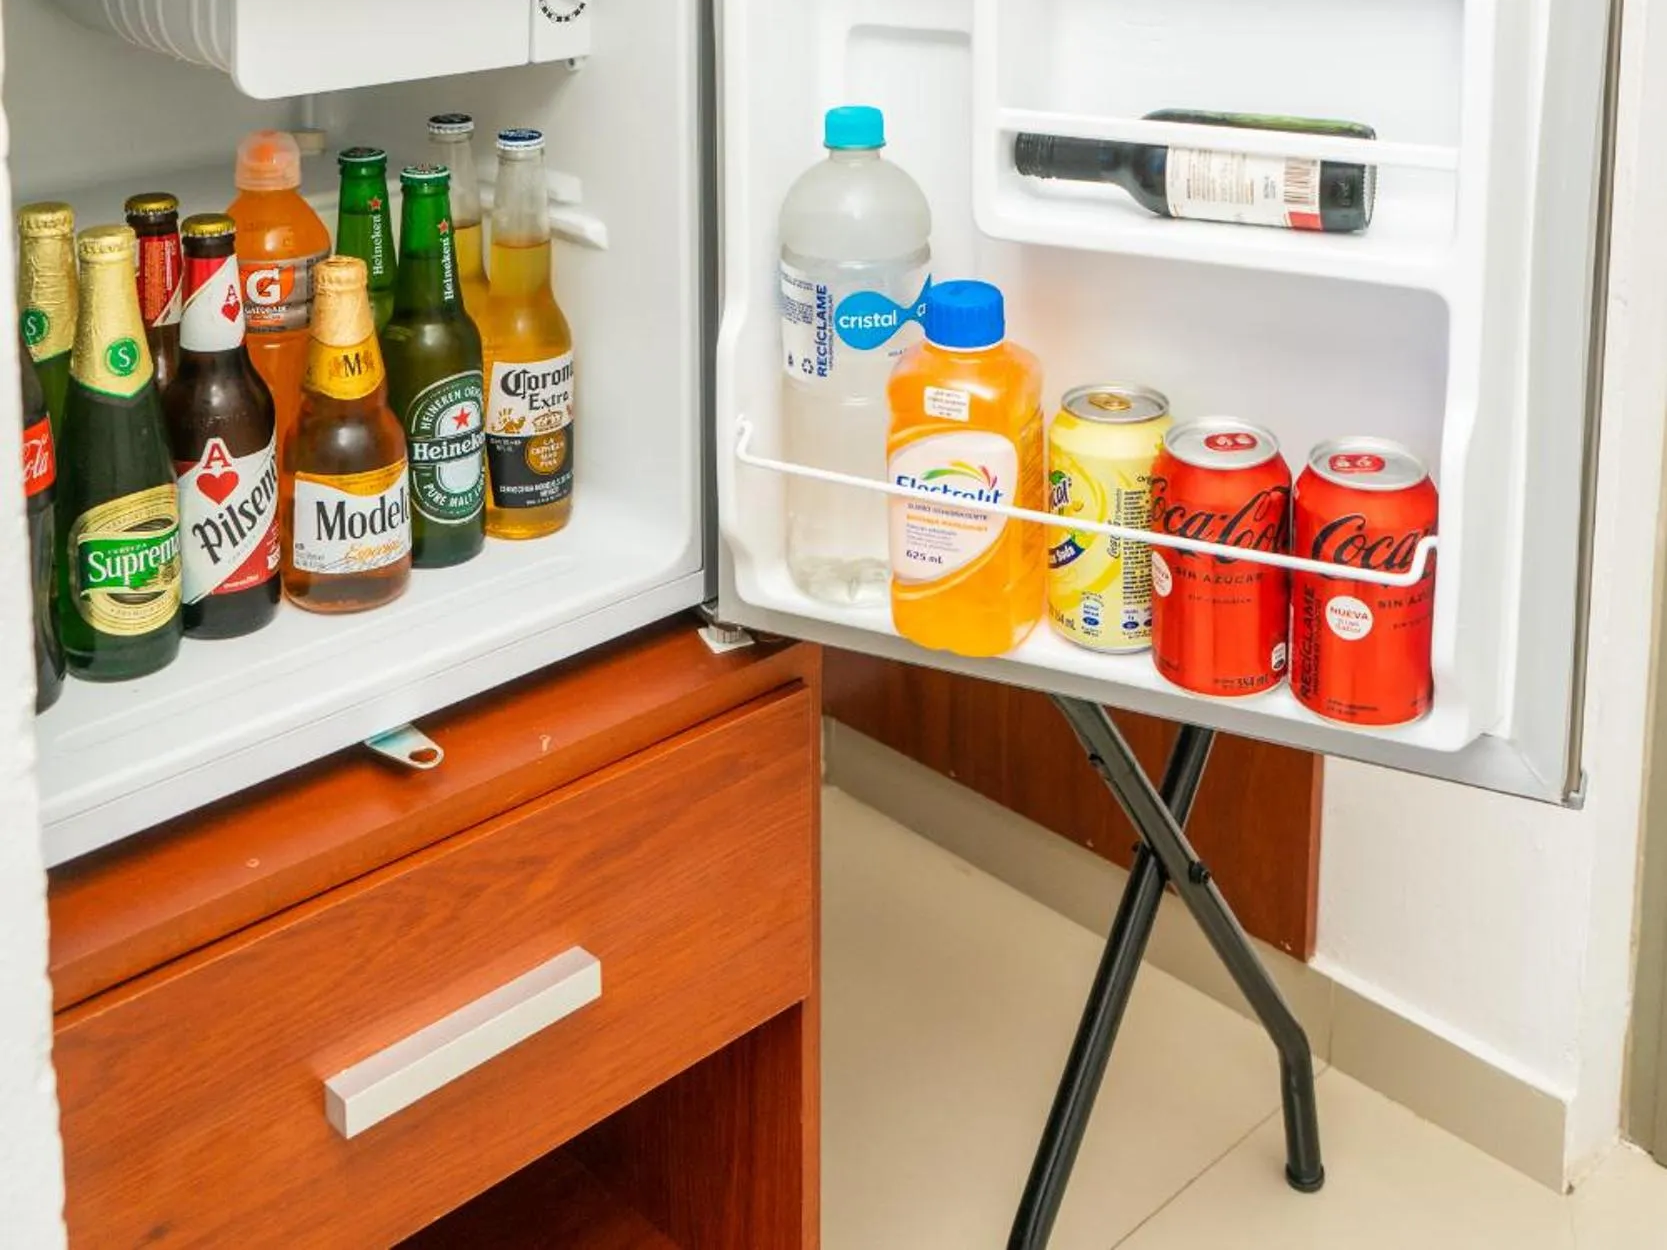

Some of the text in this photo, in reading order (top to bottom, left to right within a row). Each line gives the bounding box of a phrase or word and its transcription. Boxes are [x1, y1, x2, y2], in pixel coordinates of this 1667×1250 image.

[371, 214, 384, 276] Heineken
[440, 236, 454, 301] Heineken
[246, 268, 281, 305] G
[24, 316, 37, 336] S
[815, 285, 828, 377] RECÍCLAME
[839, 310, 897, 329] cristal
[118, 347, 131, 368] S
[343, 353, 362, 377] M
[420, 389, 462, 430] HEINEKEN
[529, 391, 569, 410] Extra
[203, 442, 232, 469] A
[424, 482, 447, 507] PURE
[449, 492, 474, 508] MALT
[906, 548, 926, 561] 625
[1330, 606, 1368, 620] NUEVA
